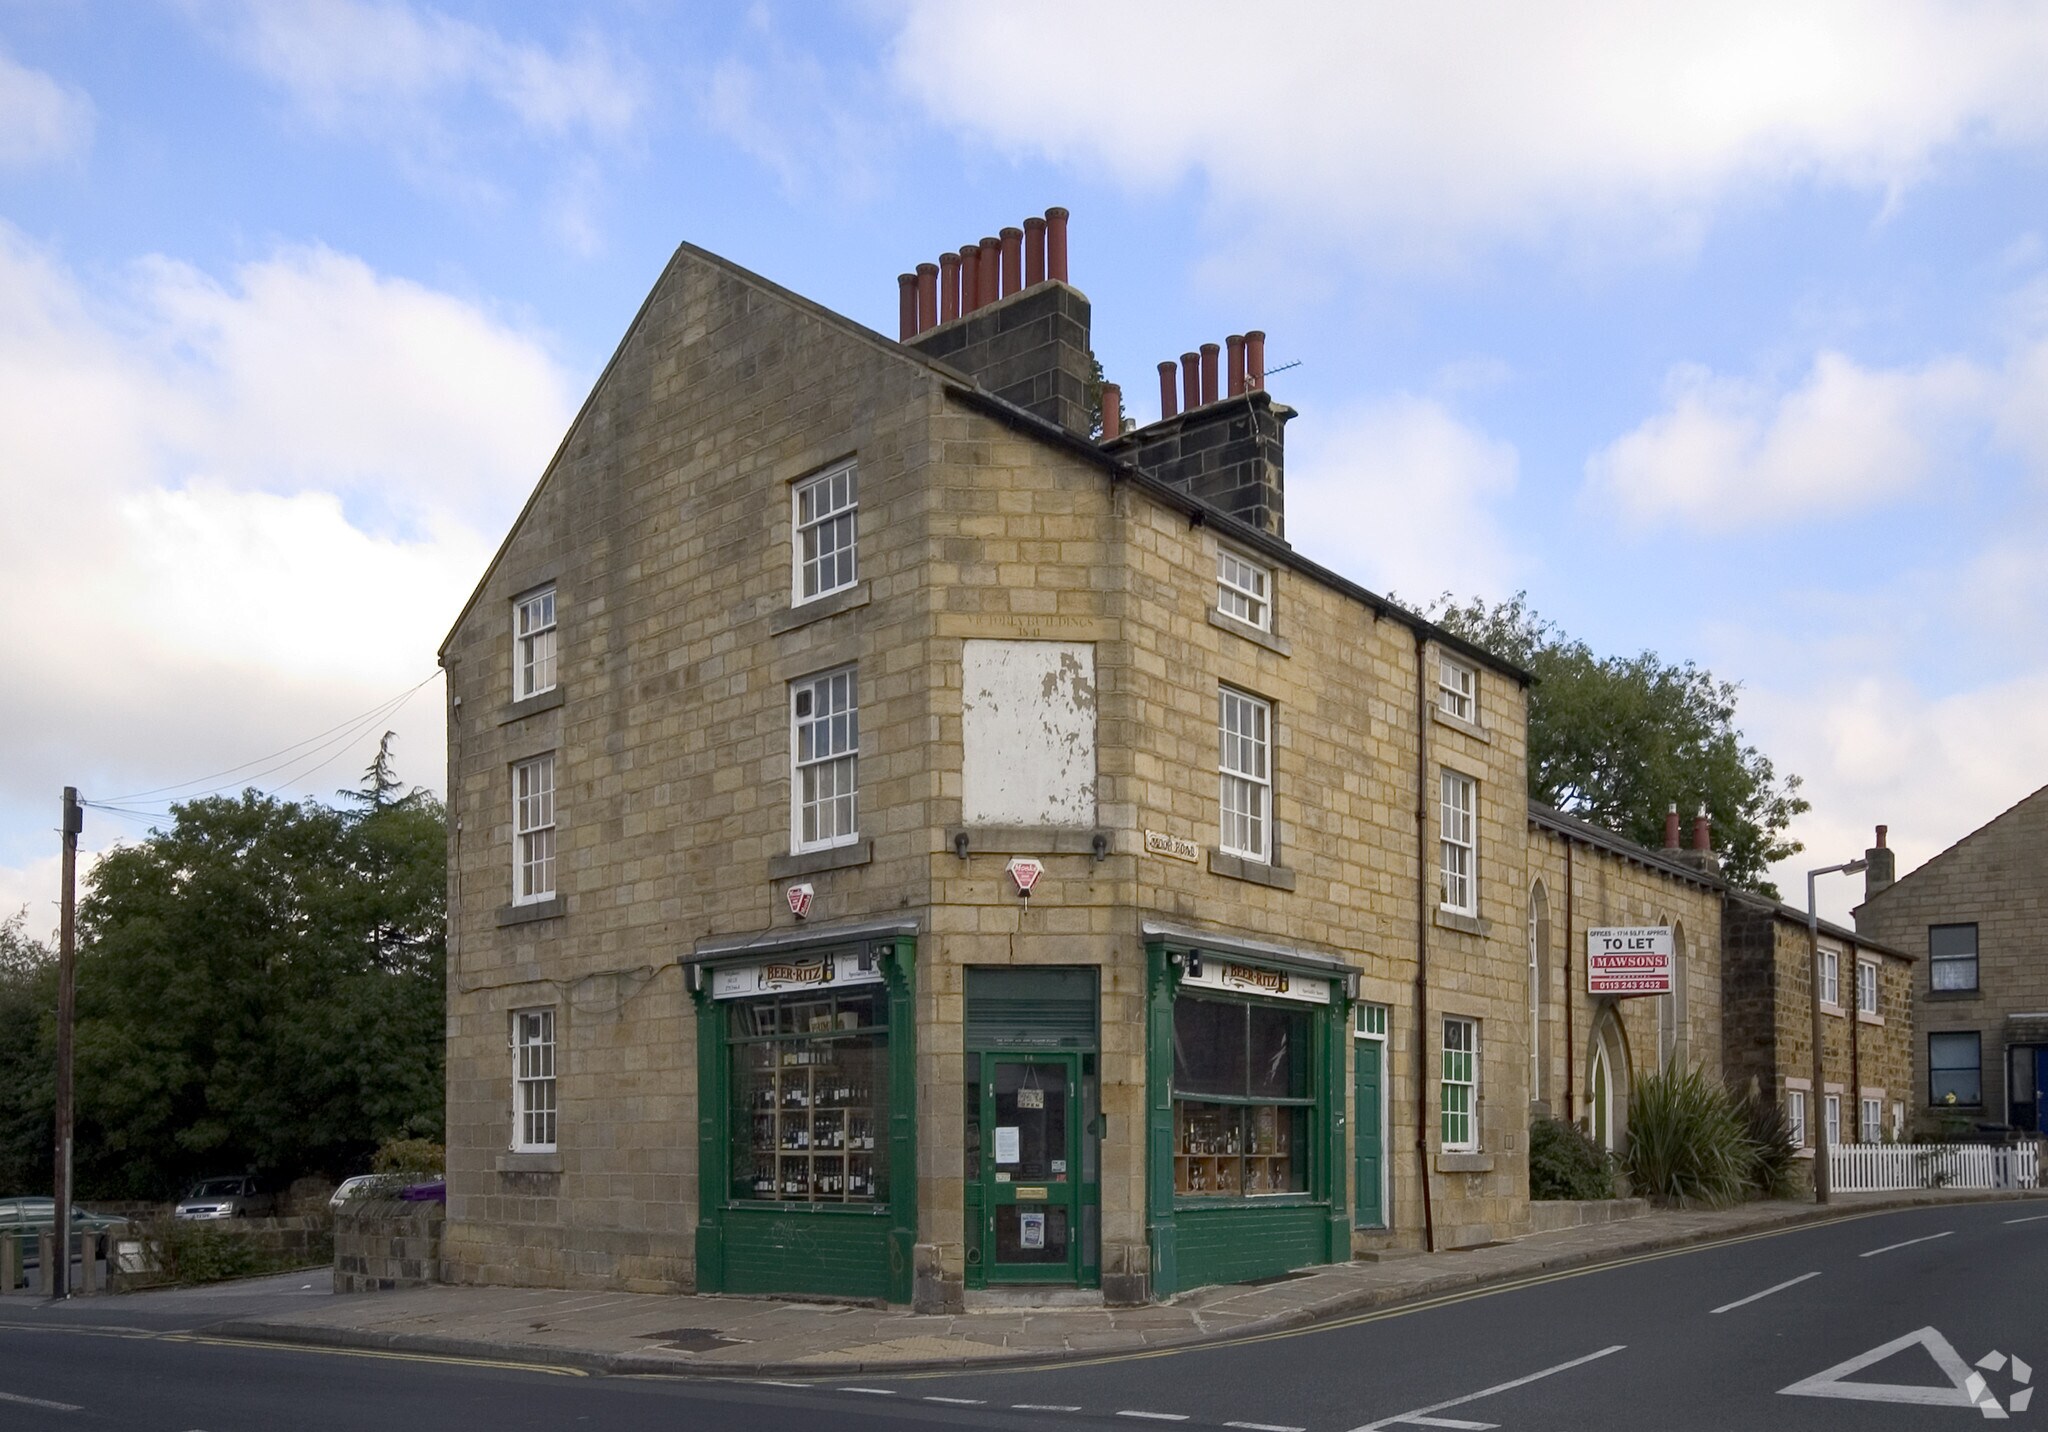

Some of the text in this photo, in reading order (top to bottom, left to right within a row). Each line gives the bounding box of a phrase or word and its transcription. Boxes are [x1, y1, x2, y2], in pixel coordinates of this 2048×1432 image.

[1603, 938, 1655, 949] TO LET
[1597, 956, 1663, 967] MAWSONS
[1600, 981, 1661, 989] 0113 243 2432
